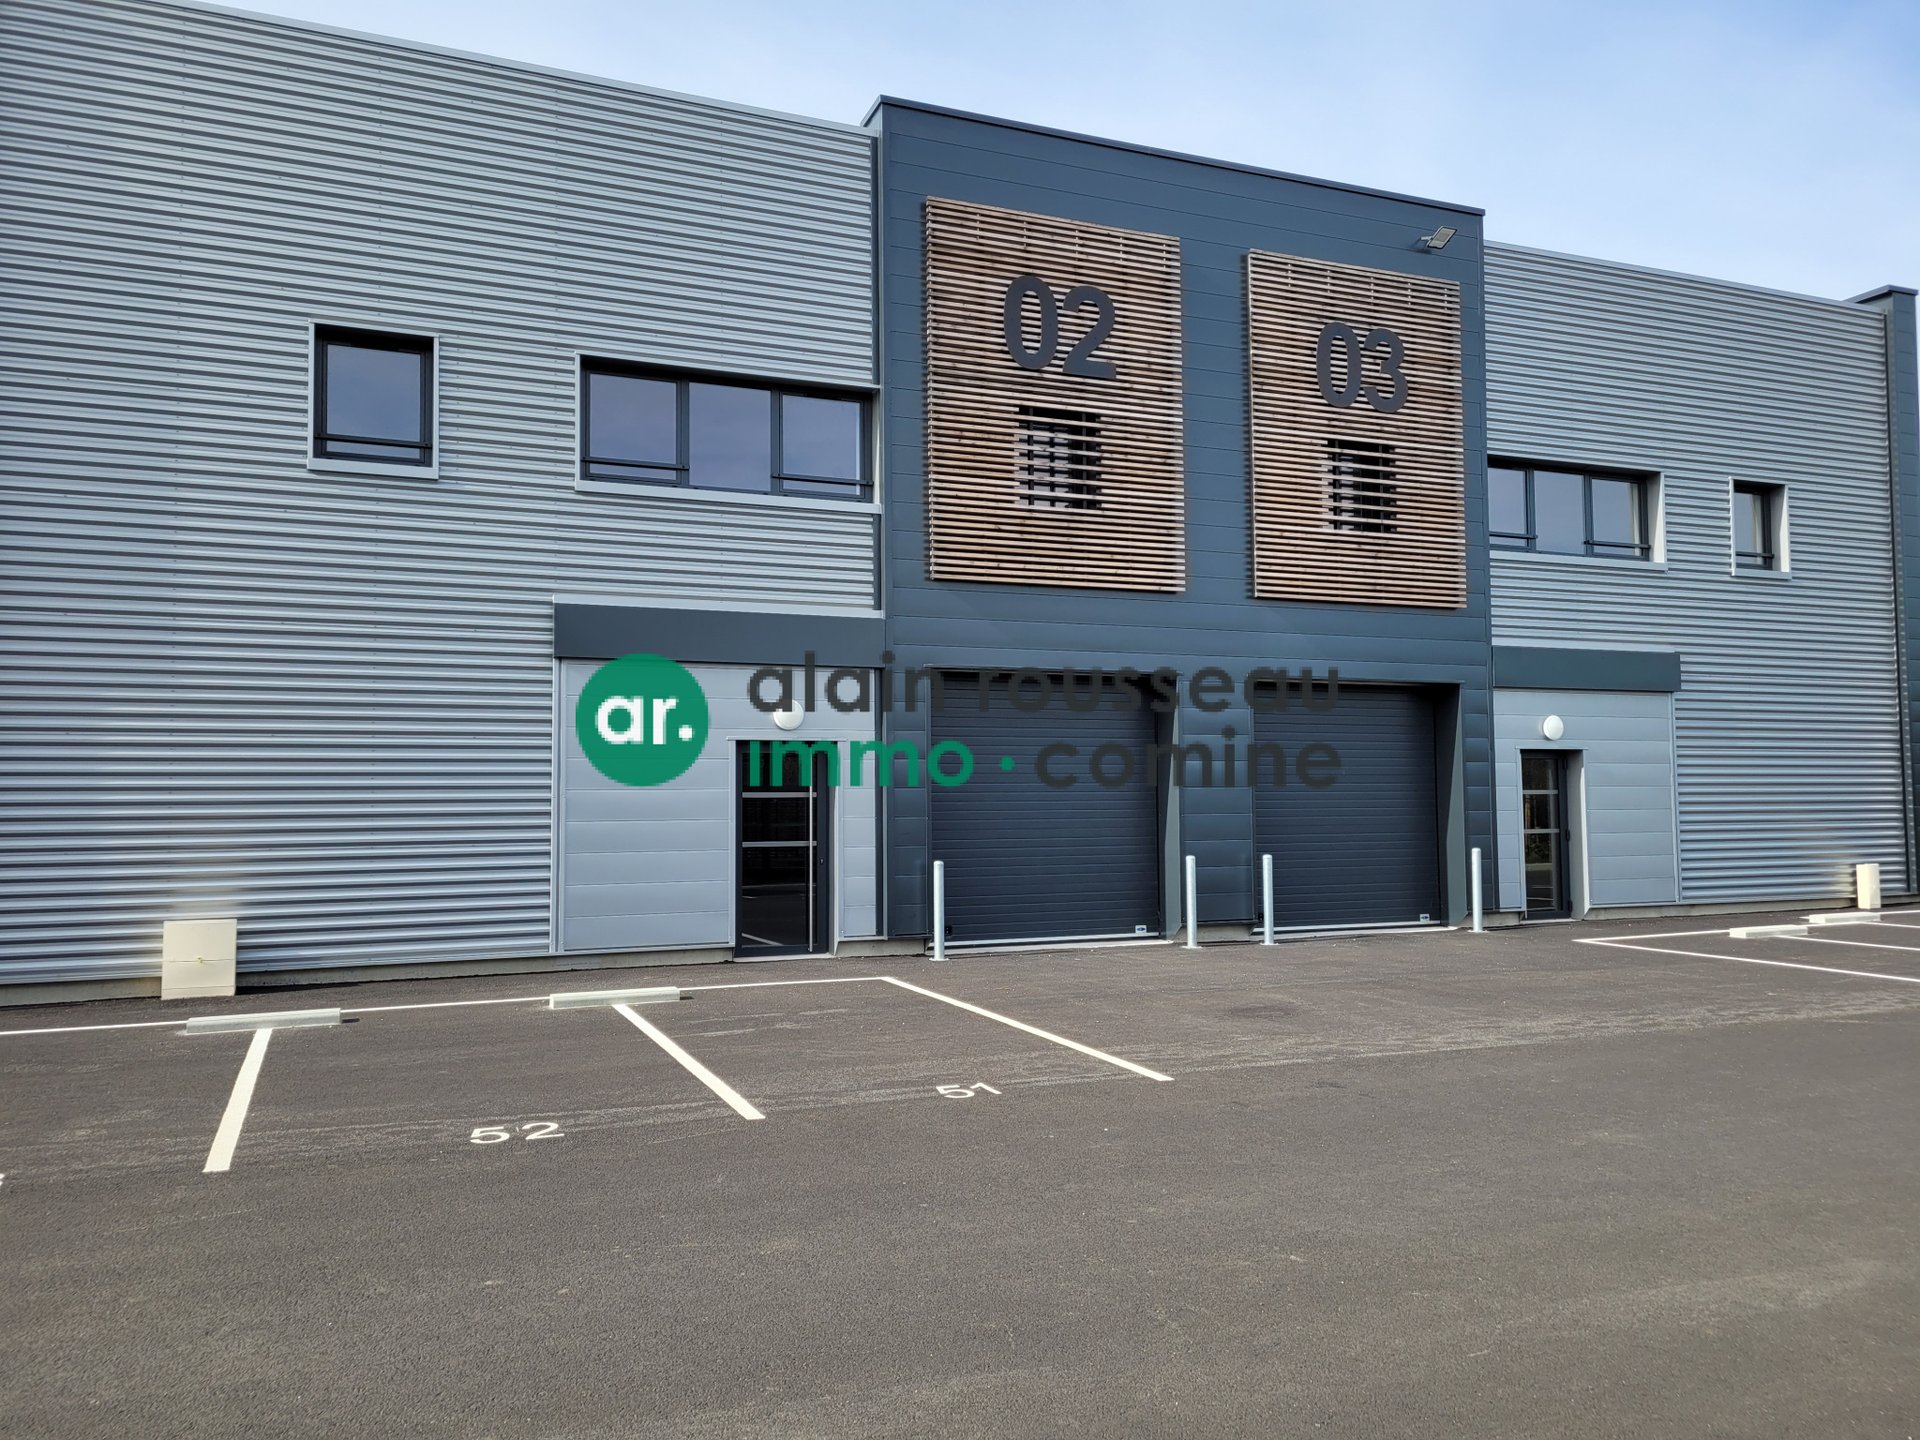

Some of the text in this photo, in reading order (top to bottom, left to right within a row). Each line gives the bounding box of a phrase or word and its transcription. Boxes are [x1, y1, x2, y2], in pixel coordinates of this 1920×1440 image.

[1003, 275, 1117, 379] 02
[1316, 322, 1408, 412] 03
[935, 1082, 1002, 1099] 51
[469, 1121, 565, 1145] 52
